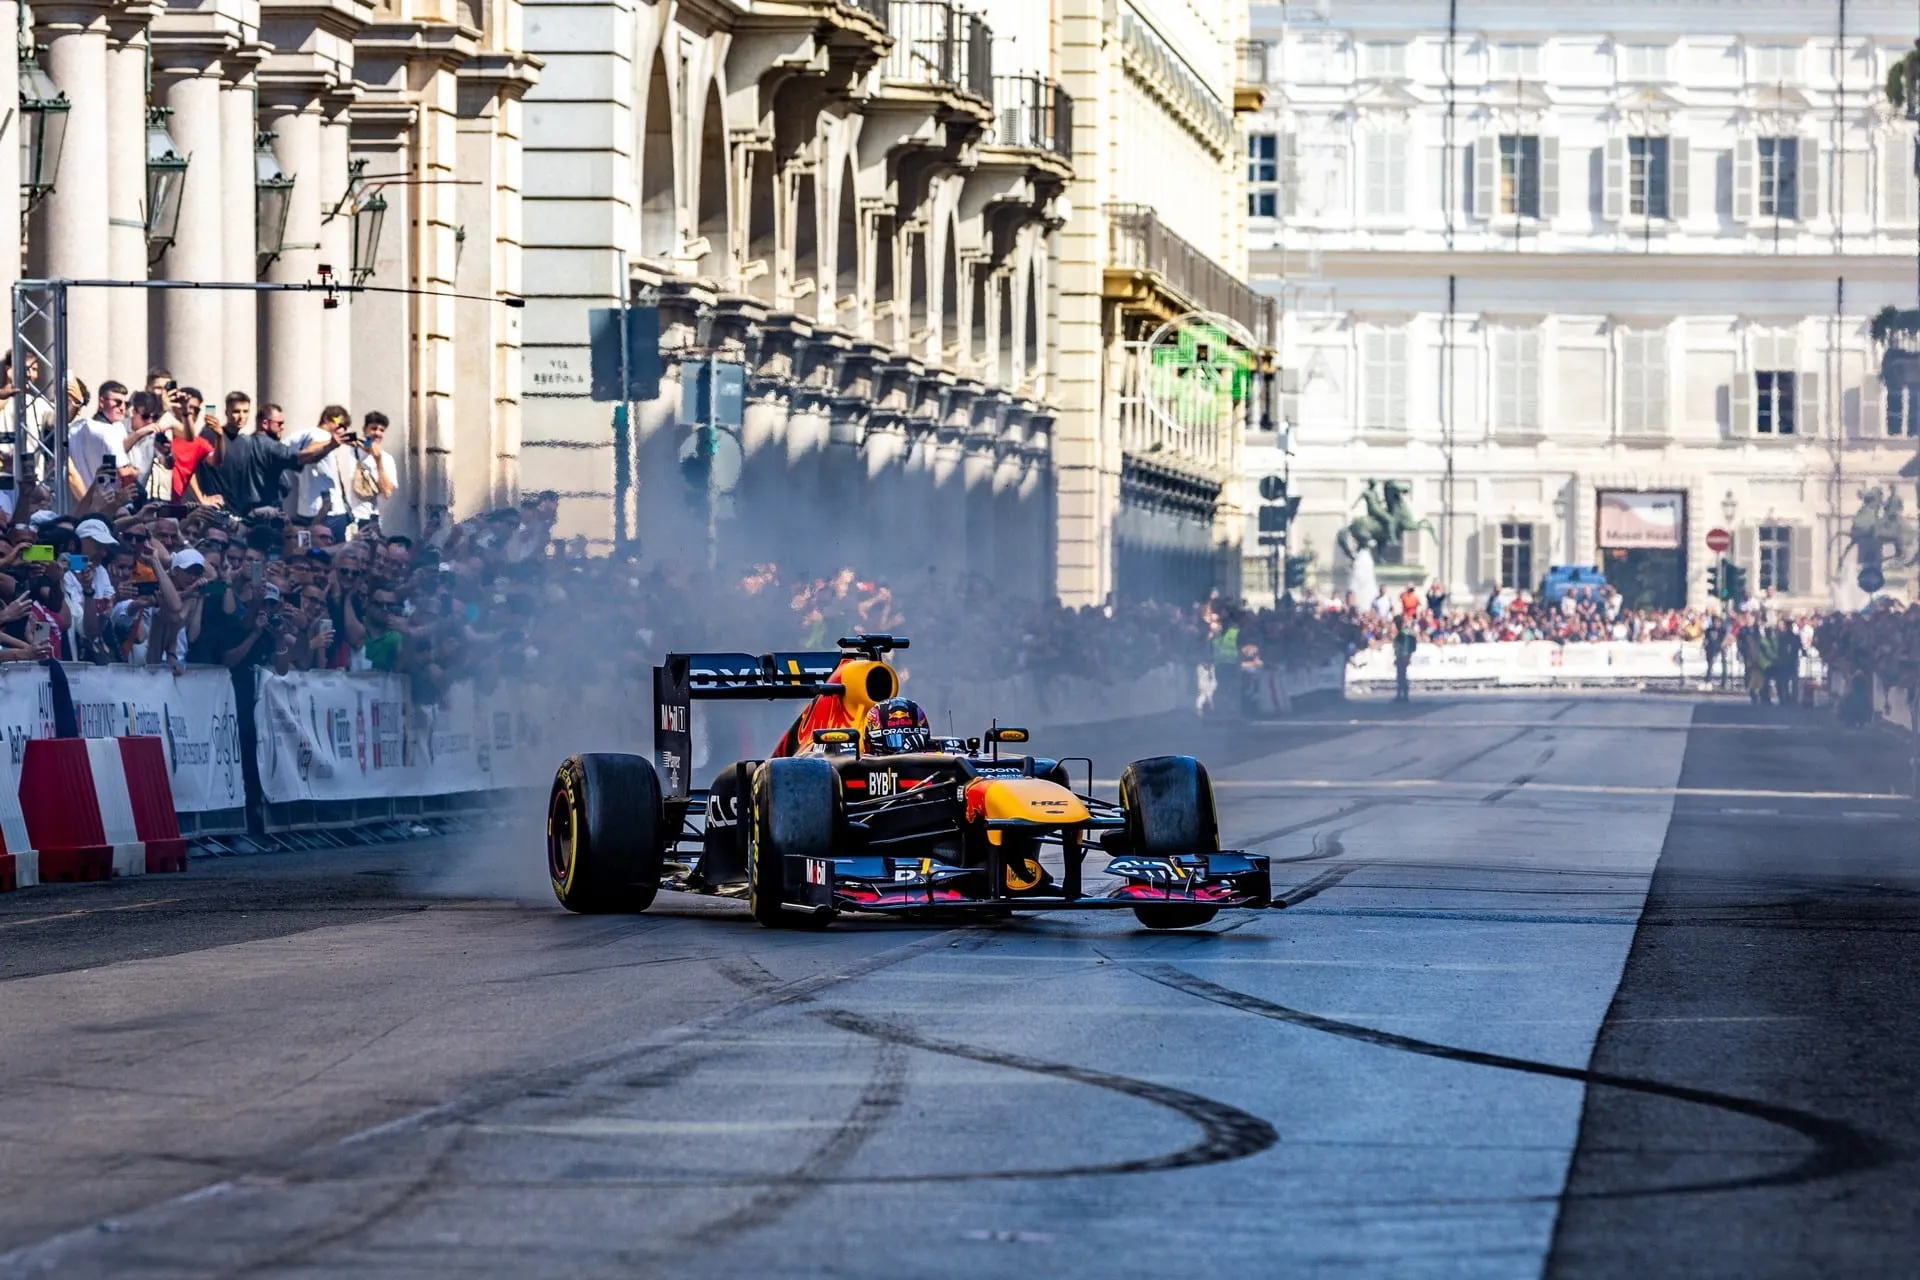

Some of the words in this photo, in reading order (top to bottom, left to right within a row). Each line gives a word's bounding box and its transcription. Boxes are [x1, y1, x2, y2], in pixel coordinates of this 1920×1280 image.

[661, 704, 678, 731] Mobil
[882, 727, 920, 735] ORACLE
[868, 767, 898, 796] BYBIT
[806, 858, 826, 886] Mobil
